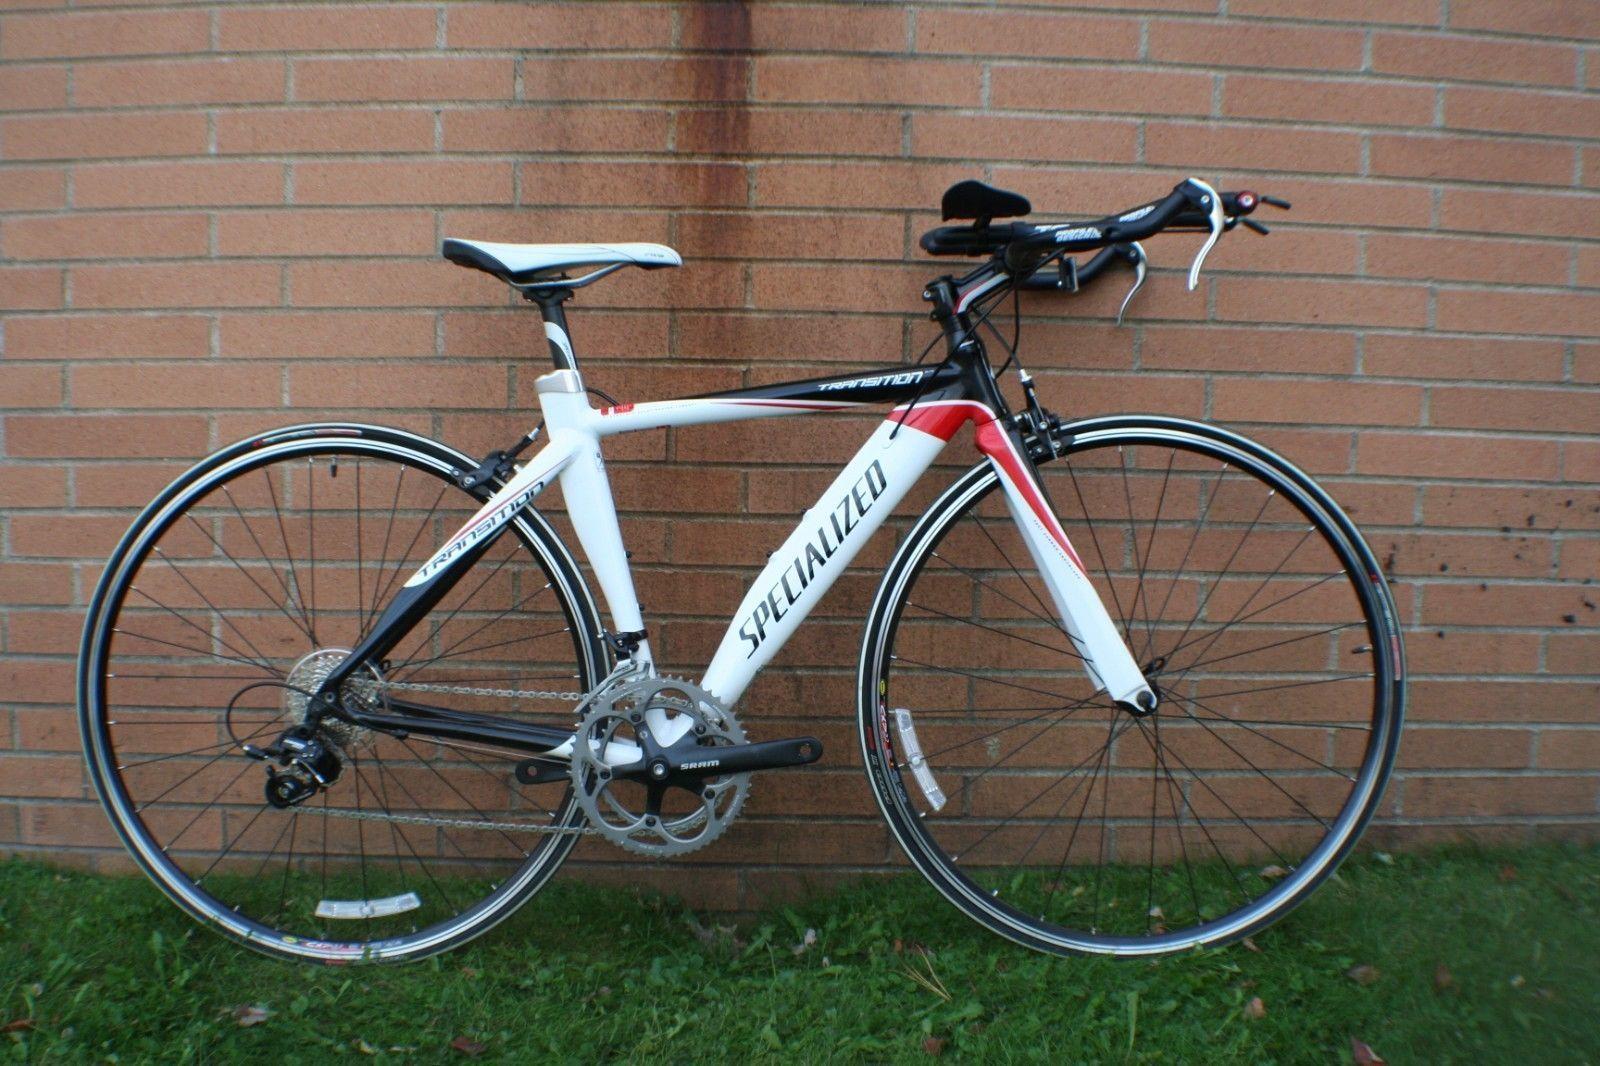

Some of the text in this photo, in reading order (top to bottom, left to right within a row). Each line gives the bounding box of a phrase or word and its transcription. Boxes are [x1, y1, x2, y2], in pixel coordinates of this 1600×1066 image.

[818, 371, 924, 391] TRANSITION
[419, 481, 544, 577] TRANSITION
[739, 459, 887, 659] SPECIALIZED
[680, 760, 720, 770] SRAM
